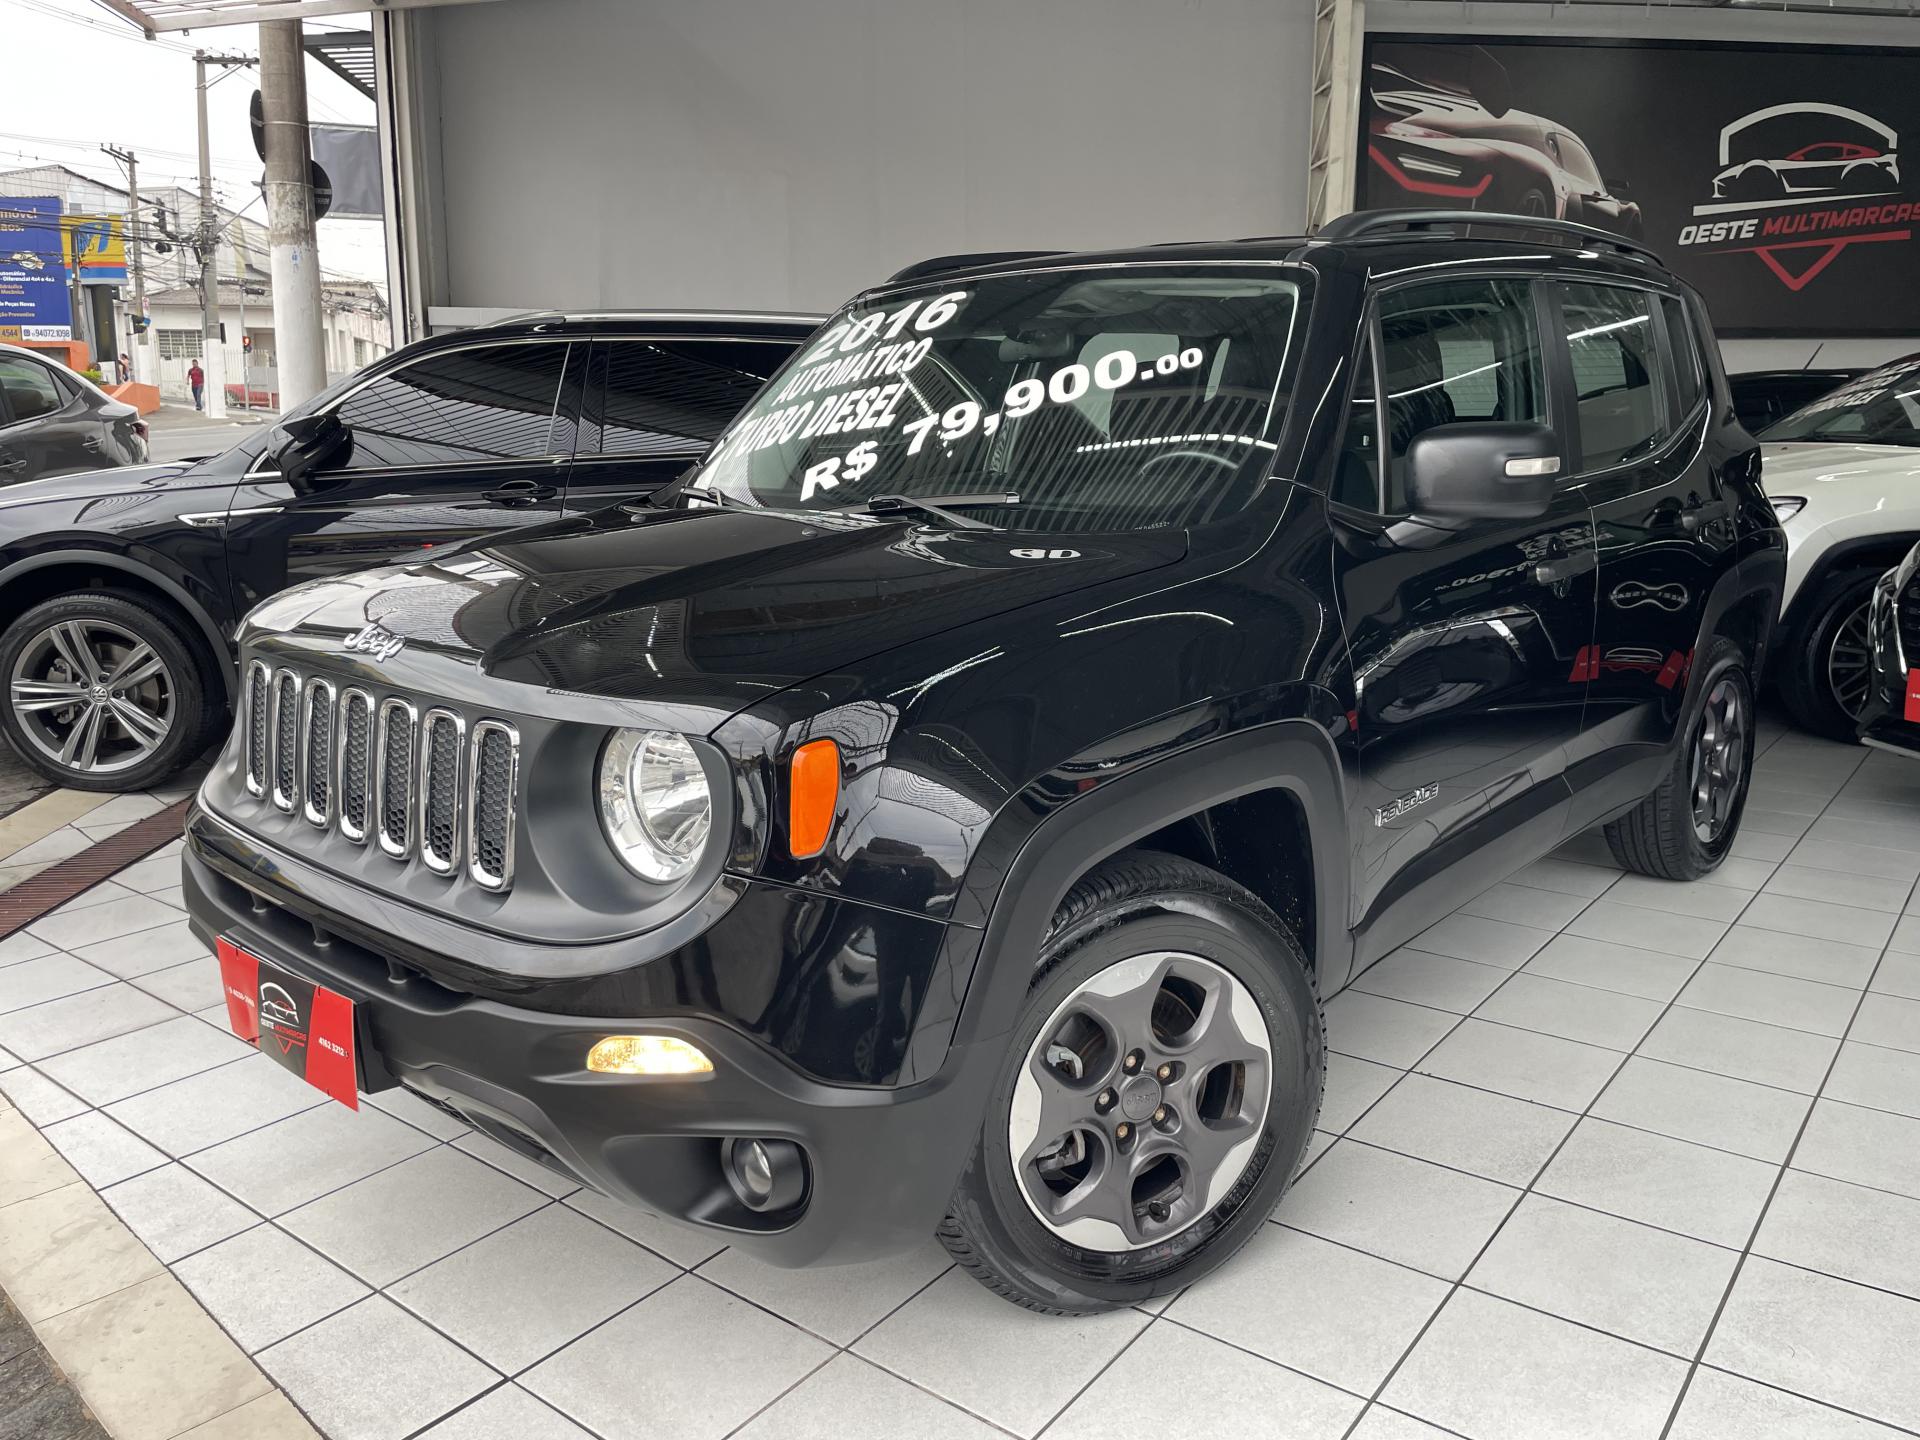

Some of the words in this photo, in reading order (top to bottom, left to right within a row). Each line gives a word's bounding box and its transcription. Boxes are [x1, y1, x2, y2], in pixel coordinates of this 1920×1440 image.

[1678, 218, 1759, 246] OESTE
[1761, 201, 1920, 236] MULTIMARCAS
[800, 291, 967, 367] 2016
[771, 336, 933, 407] AUTOMÁTICO
[734, 400, 815, 458] TURBO
[799, 383, 909, 440] DIESEL
[800, 440, 879, 501] R$
[343, 623, 406, 663] Jeep
